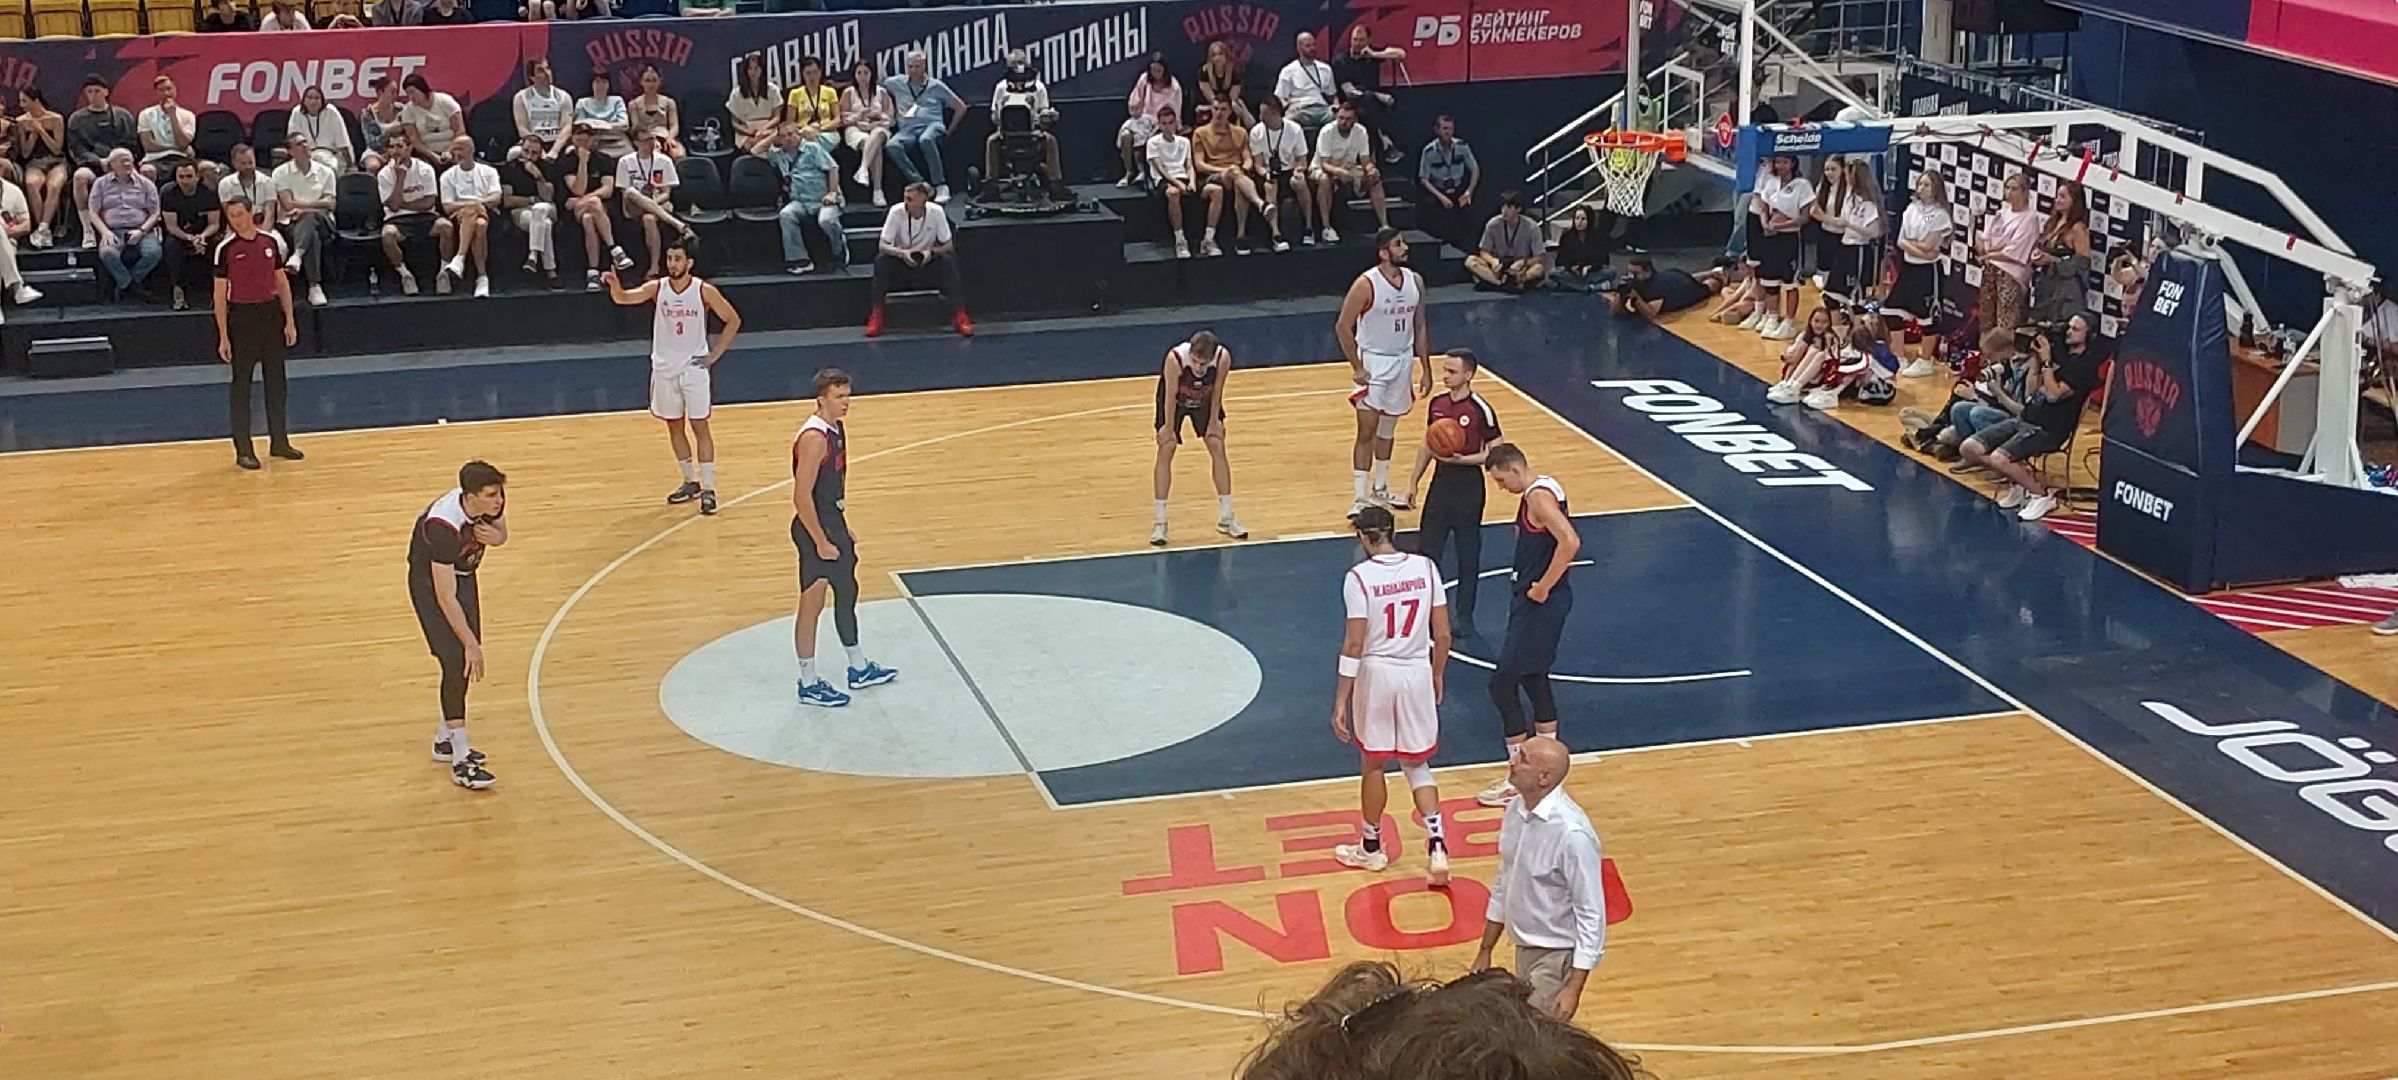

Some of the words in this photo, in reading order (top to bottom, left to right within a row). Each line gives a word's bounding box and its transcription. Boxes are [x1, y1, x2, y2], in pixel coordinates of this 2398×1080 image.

[1183, 4, 1280, 43] RUSSIA
[1470, 23, 1583, 44] БУКМЕКЕРОВ
[1471, 8, 1551, 29] РЕЙТИНГ
[585, 29, 694, 68] RUSSIA
[731, 19, 861, 90] ГАВНАЯ
[0, 56, 38, 90] IA
[206, 55, 426, 105] FONBET
[2152, 295, 2180, 318] BET
[2157, 279, 2186, 301] FON
[2123, 360, 2180, 409] RUSSIA
[1590, 379, 1875, 491] FONBET
[2113, 479, 2174, 522] FONBET
[1383, 598, 1420, 639] 17
[2139, 701, 2398, 854] JÖG
